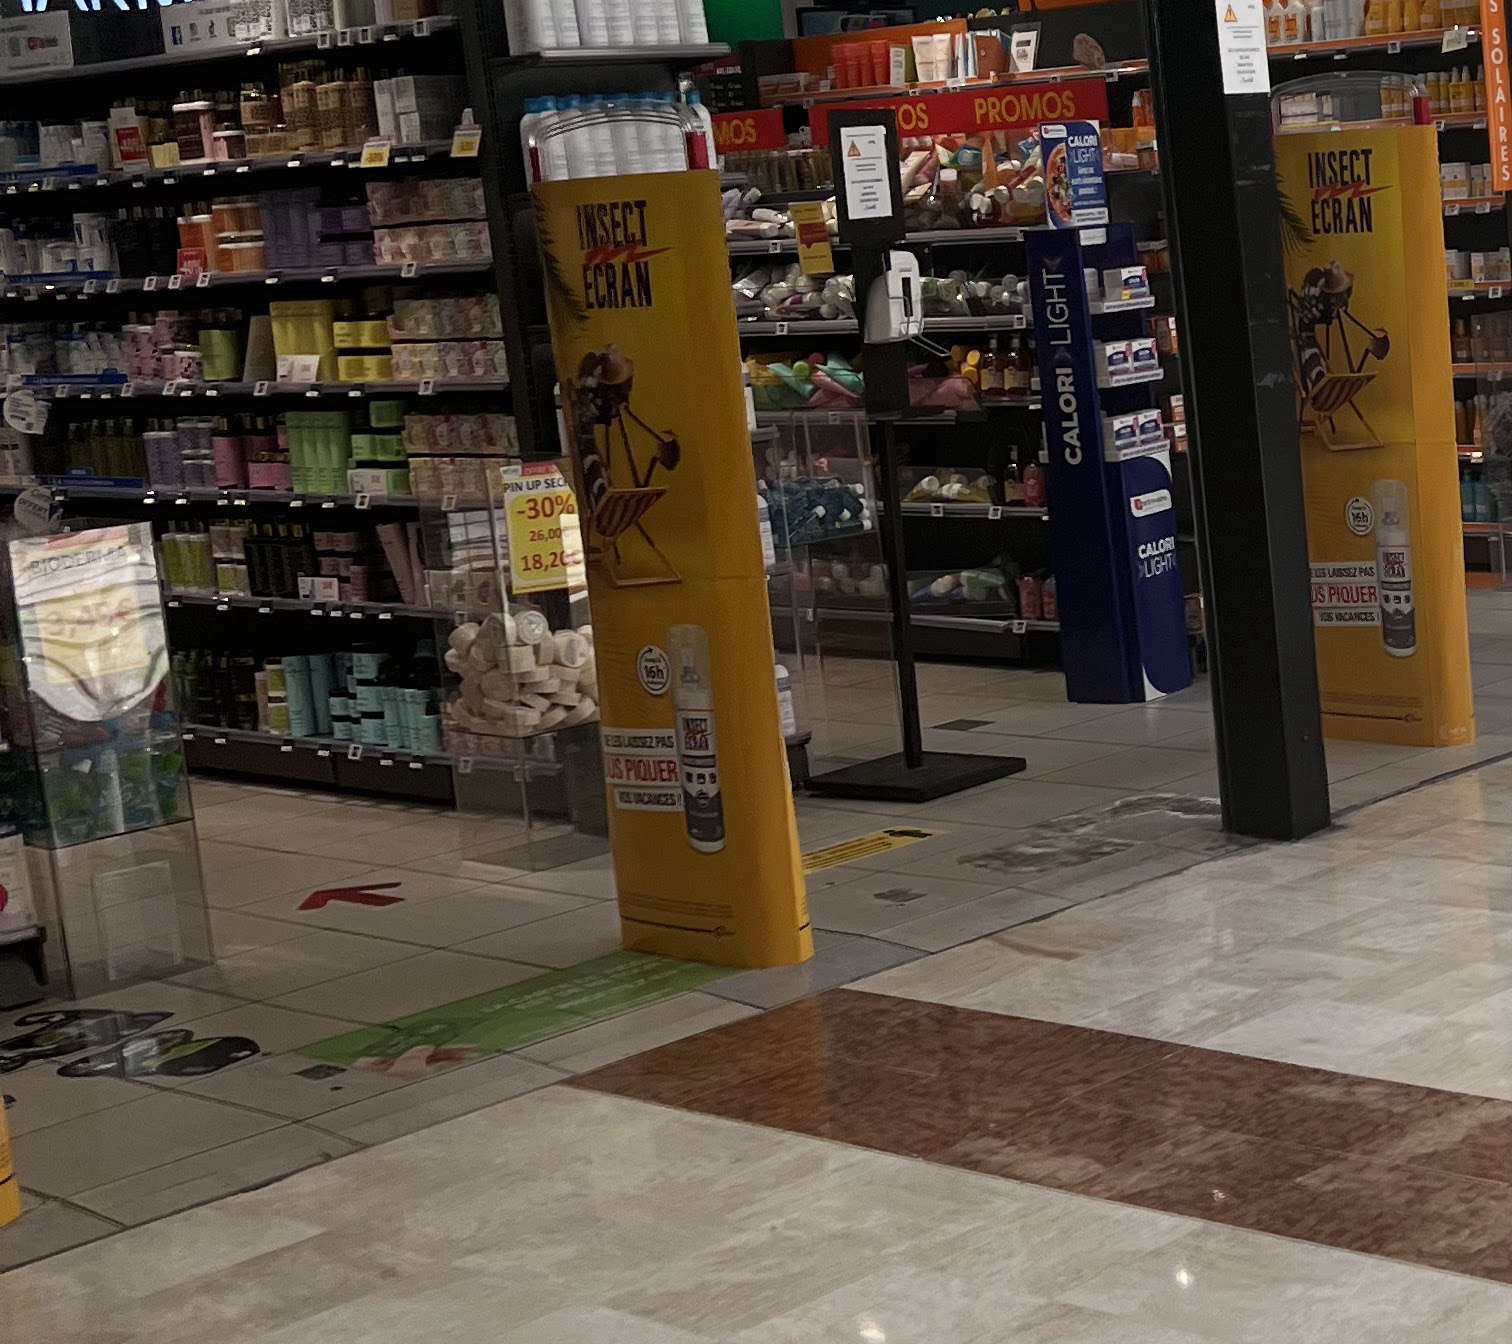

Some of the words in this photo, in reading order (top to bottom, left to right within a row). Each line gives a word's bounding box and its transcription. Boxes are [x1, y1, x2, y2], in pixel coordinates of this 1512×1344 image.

[975, 90, 1076, 126] PROMOS
[1490, 27, 1512, 182] SOLAIRES
[1308, 149, 1372, 190] INSECT
[576, 200, 648, 251] INSECT
[1311, 198, 1373, 236] ECRAN
[583, 260, 653, 310] ECRAN
[1041, 267, 1072, 346] LIGHT
[1055, 366, 1083, 466] CALORI
[503, 481, 524, 493] PIN
[526, 479, 542, 491] UP
[517, 493, 575, 520] -30%
[1138, 536, 1175, 560] CALORI
[1144, 552, 1173, 578] LIGHT
[1358, 566, 1376, 578] PAS
[1311, 585, 1326, 604] US
[1328, 585, 1378, 604] PIQUER
[1334, 611, 1376, 622] VACANCES
[655, 735, 675, 749] PAS
[607, 757, 624, 780] US
[624, 758, 680, 782] PIQUER
